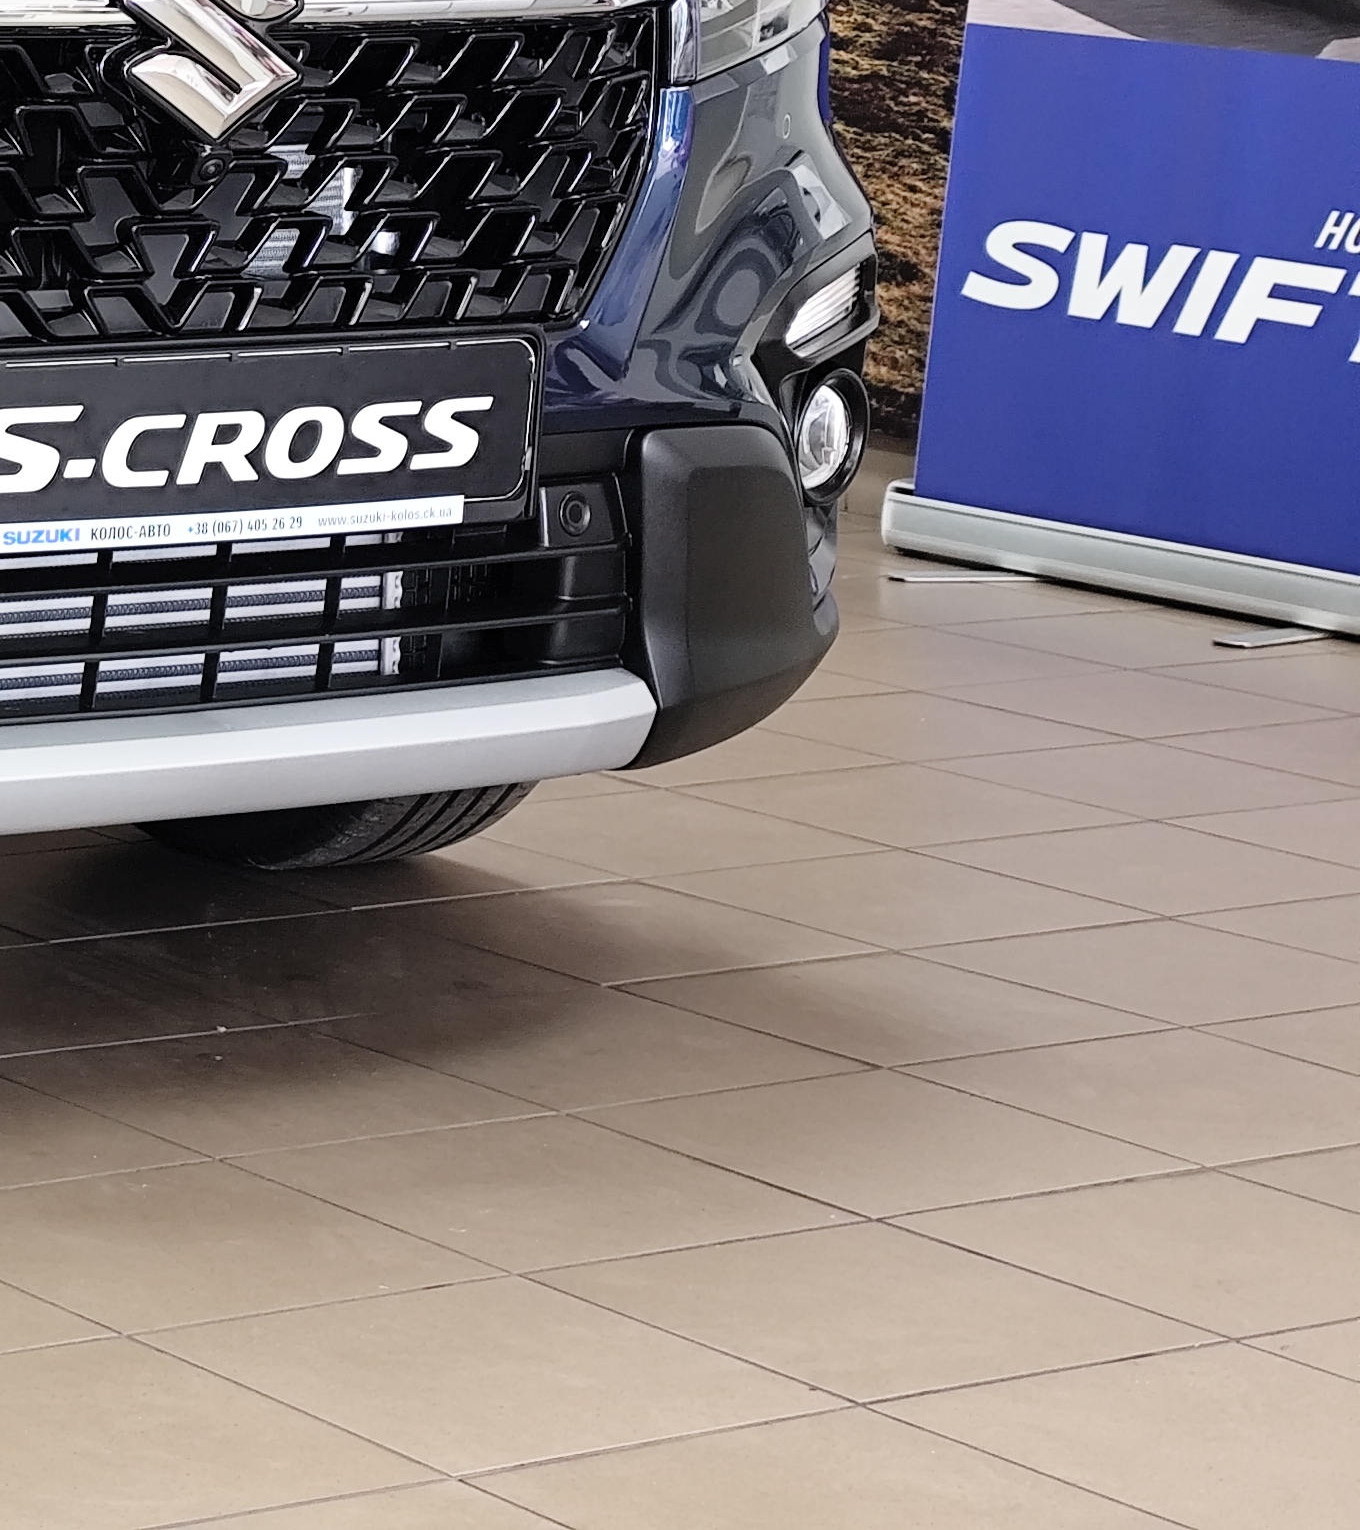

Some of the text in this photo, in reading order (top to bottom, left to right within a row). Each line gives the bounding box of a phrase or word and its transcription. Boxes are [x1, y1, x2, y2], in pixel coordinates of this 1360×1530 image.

[960, 219, 1360, 364] SWIF
[2, 506, 452, 546] SUZUKI КОЛОС-АВТО +38 (067) 405 26 29 www.suzuki-kolos.ck.ua
